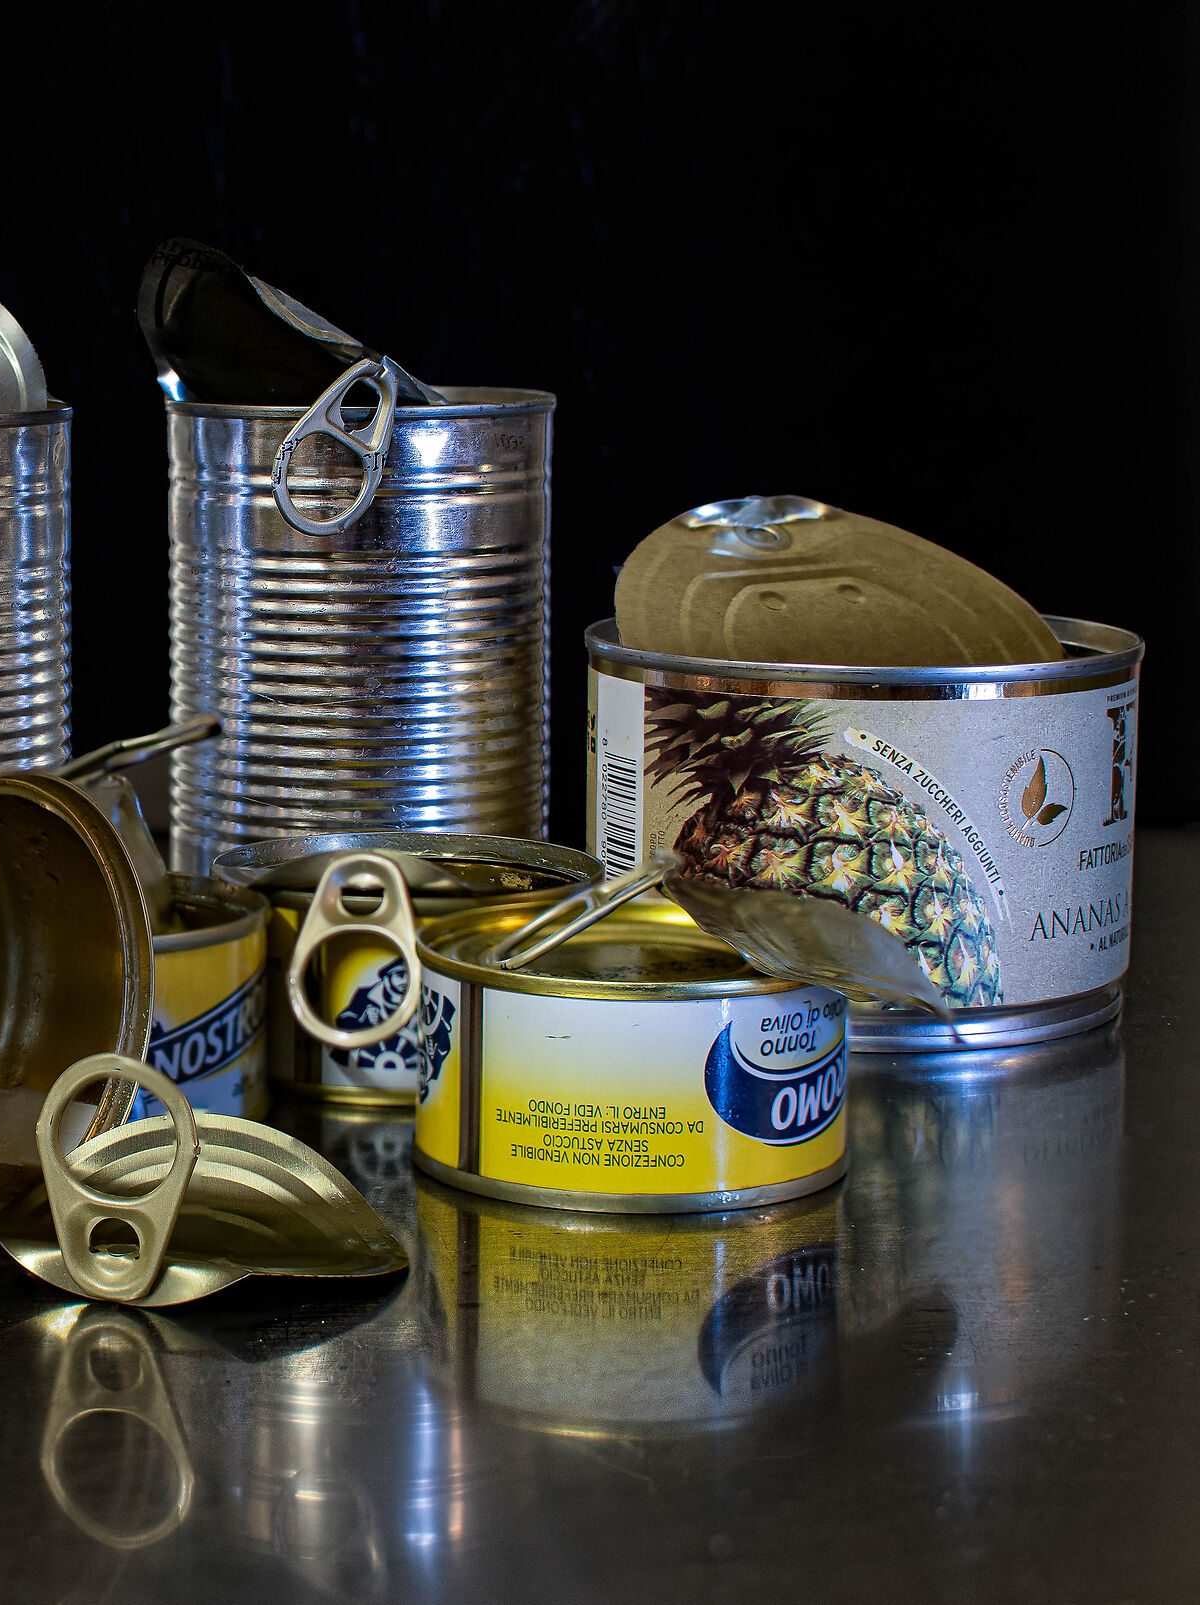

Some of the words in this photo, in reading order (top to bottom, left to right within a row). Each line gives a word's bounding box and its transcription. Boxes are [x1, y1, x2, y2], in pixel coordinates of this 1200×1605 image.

[602, 737, 609, 747] 8
[871, 739, 914, 775] SENZA
[912, 769, 967, 826] ZUCCHERI
[961, 825, 1001, 884] AGGIUNTI
[1079, 841, 1121, 871] FATTORIA
[1028, 892, 1121, 942] ANANAS
[760, 1012, 803, 1034] Oliva
[806, 1007, 820, 1029] di
[760, 1030, 816, 1057] Tonno
[771, 1056, 846, 1131] ROMO
[528, 1099, 572, 1117] FONDO
[574, 1104, 602, 1119] VEDI
[606, 1105, 621, 1119] IL:
[623, 1105, 666, 1120] ENTRO
[495, 1108, 598, 1133] PREFERIBILMENTE
[601, 1119, 685, 1135] CONSUMARSI
[687, 1119, 704, 1134] DA
[543, 1133, 604, 1150] ASTUCCIO
[607, 1138, 649, 1153] SENZA
[510, 1143, 570, 1164] VENDIBILE
[572, 1152, 600, 1166] NON
[603, 1153, 685, 1168] CONFEZIONE
